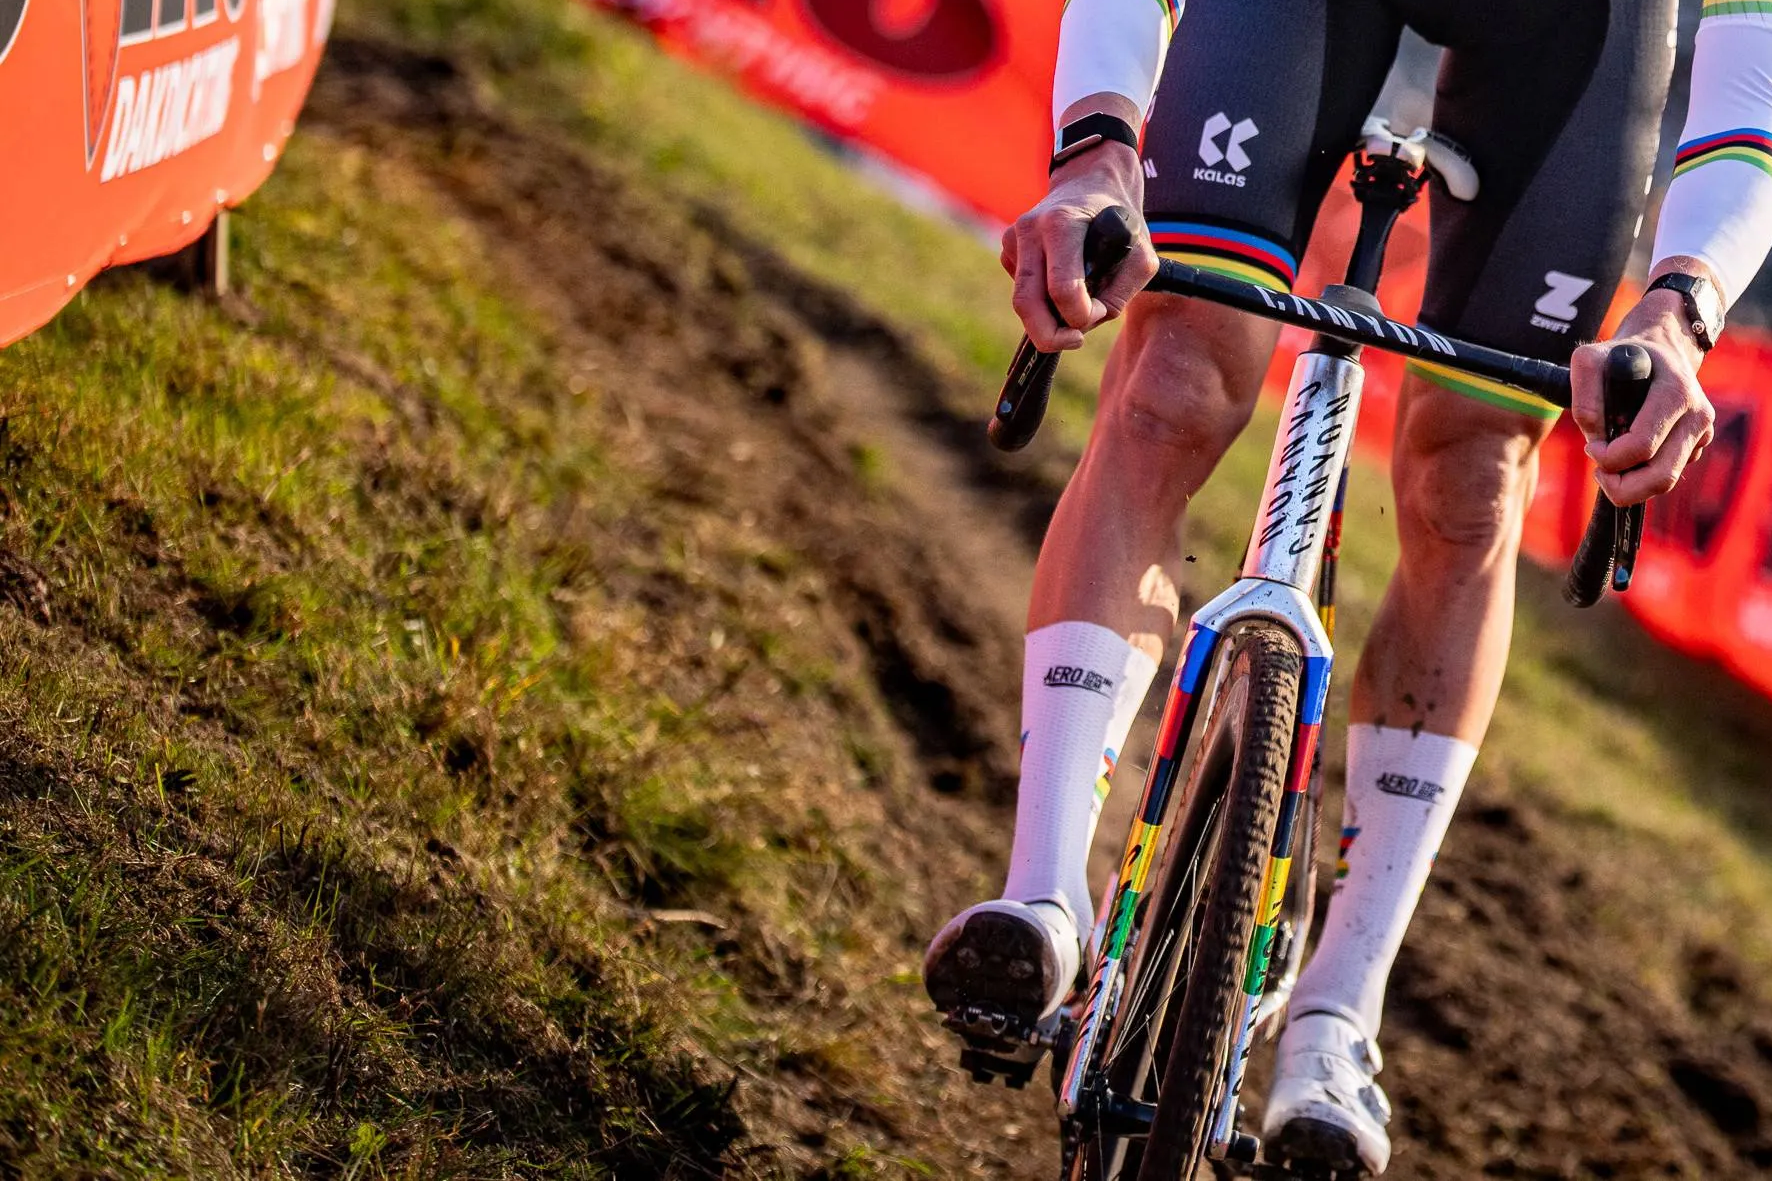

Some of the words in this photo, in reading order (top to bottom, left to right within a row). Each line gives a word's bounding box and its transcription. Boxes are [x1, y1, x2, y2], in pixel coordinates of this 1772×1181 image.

[1254, 285, 1457, 357] CANYON
[1529, 313, 1571, 334] ZWIFT
[1258, 381, 1322, 549] CANYON
[1288, 392, 1351, 557] CANYON
[1044, 666, 1083, 685] AERO
[1376, 772, 1419, 793] AERO
